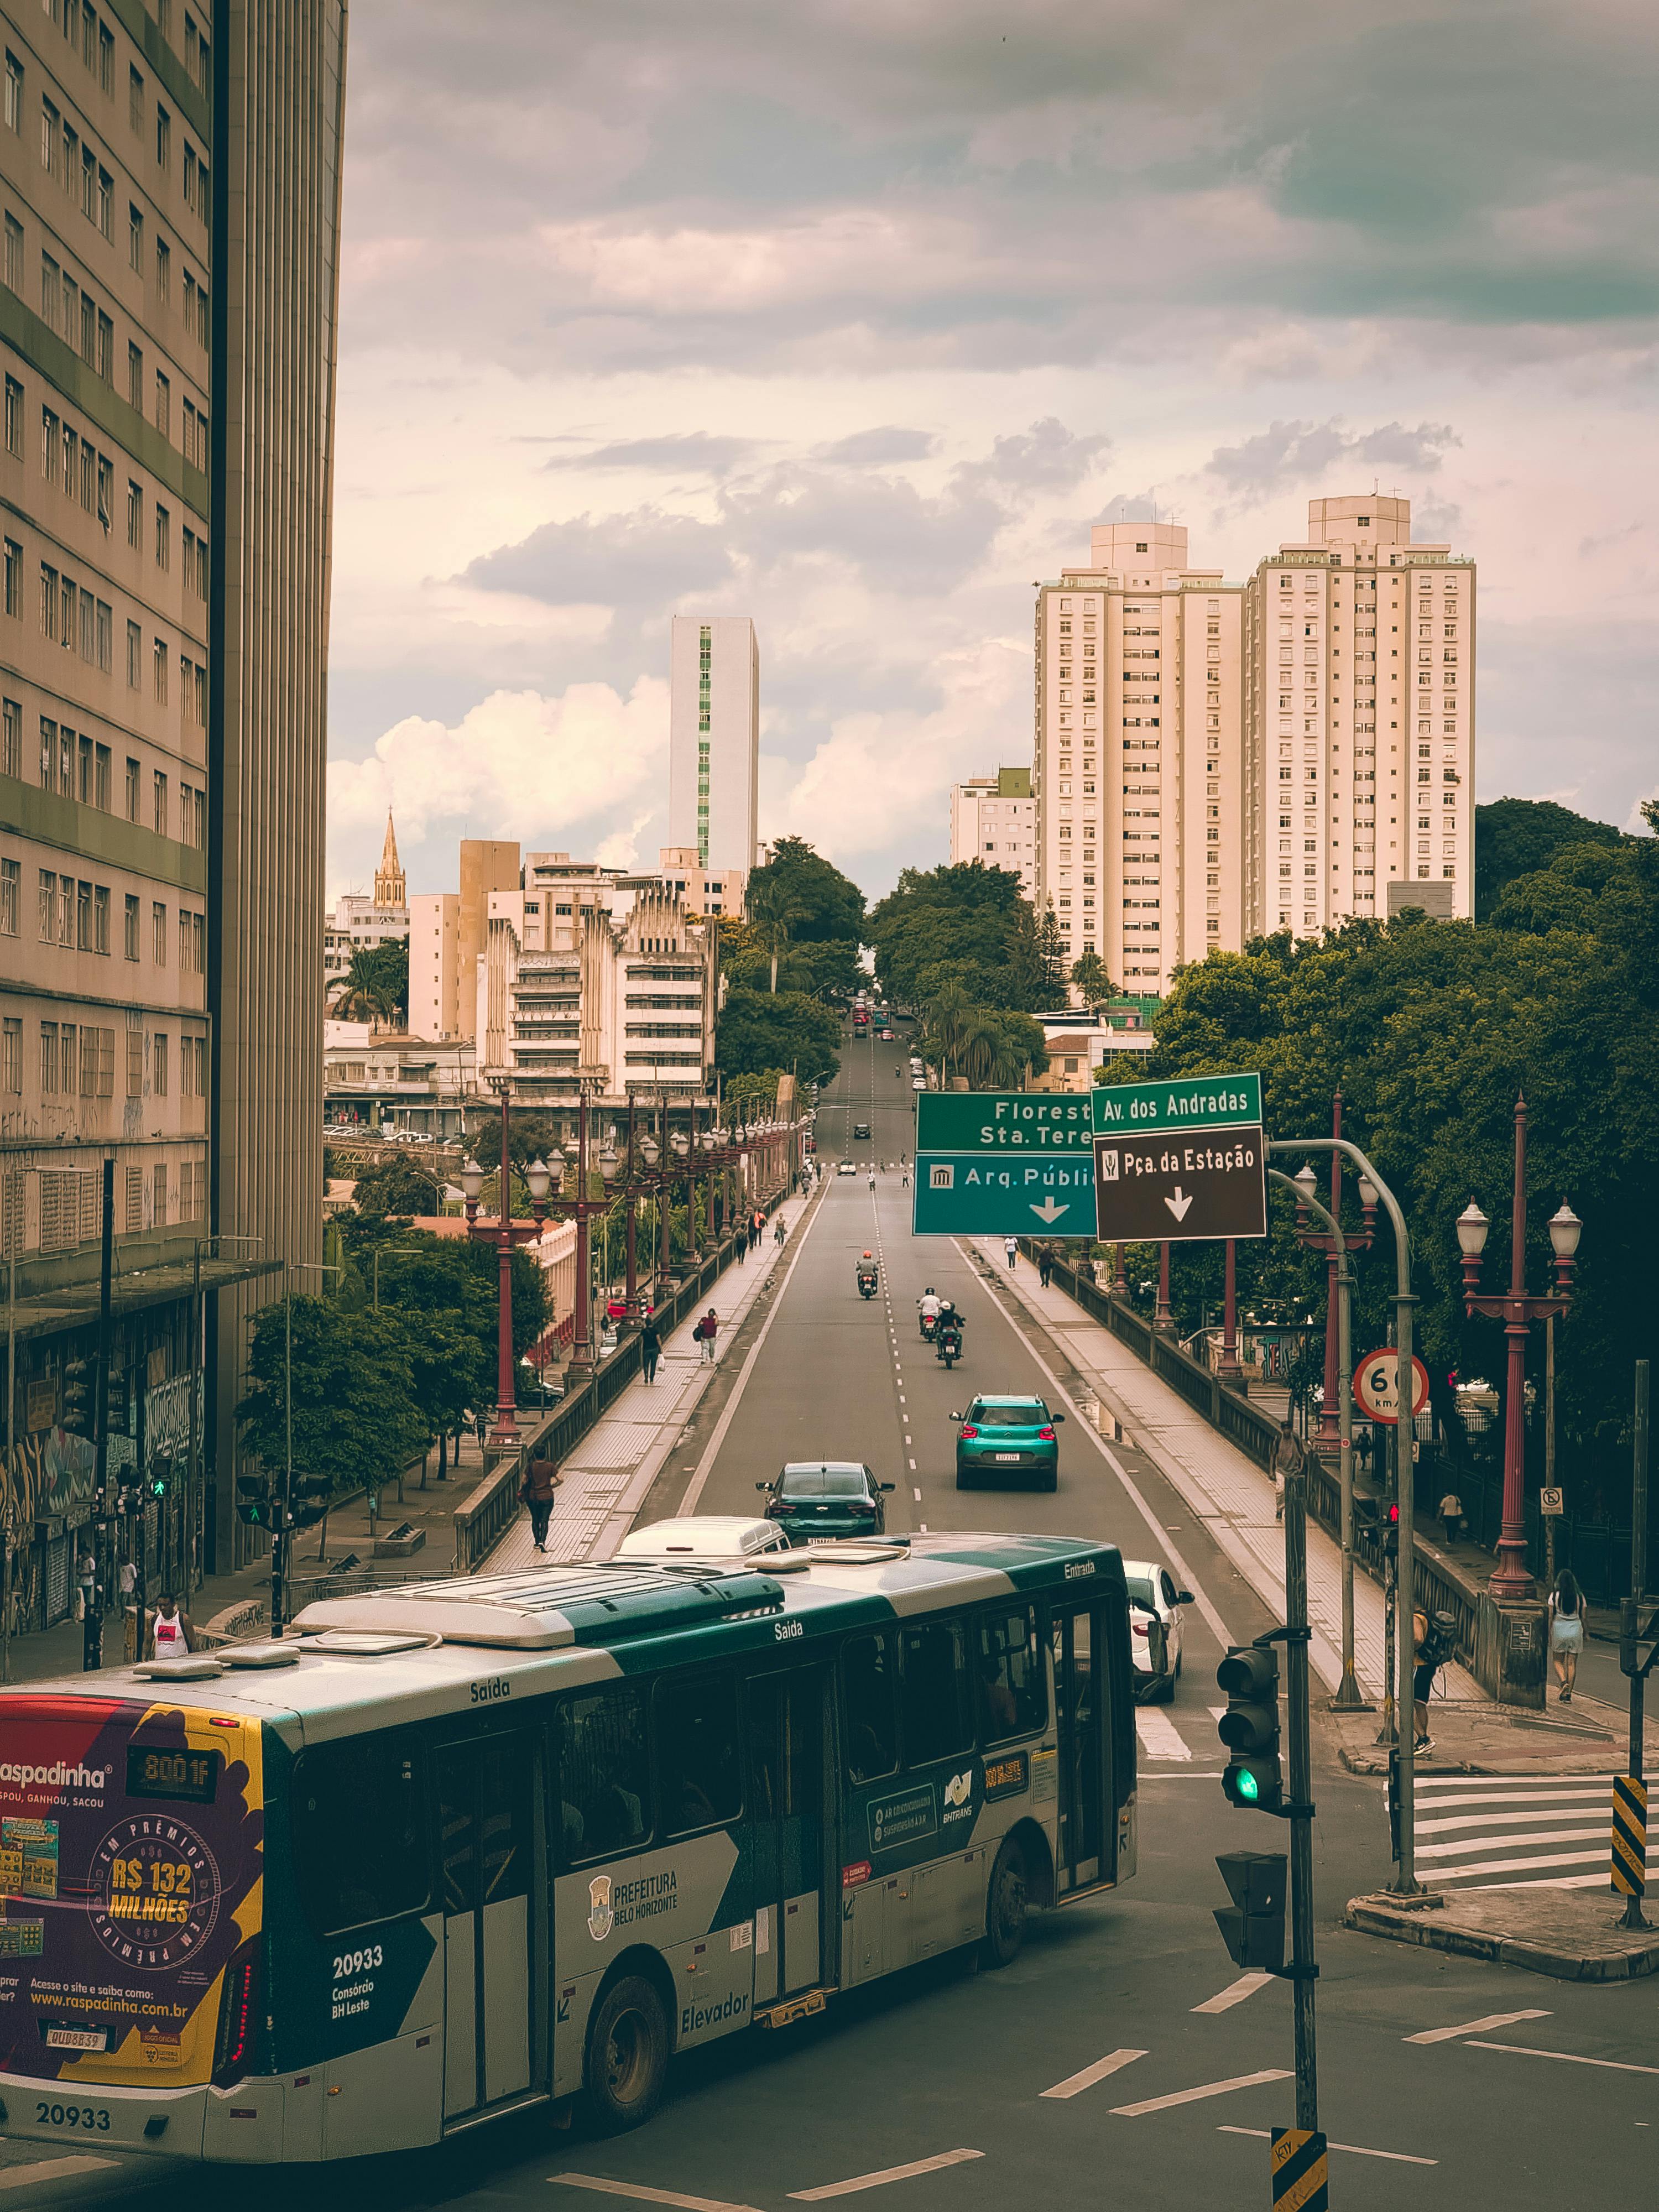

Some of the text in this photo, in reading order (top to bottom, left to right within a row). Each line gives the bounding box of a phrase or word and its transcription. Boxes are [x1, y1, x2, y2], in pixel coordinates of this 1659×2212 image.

[1104, 1091, 1248, 1122] Av. dos Andradas
[980, 1126, 1029, 1144] Sta.
[1124, 1144, 1254, 1177] Pça. da Estação
[965, 1168, 1017, 1188] Arq.
[1370, 1368, 1398, 1392] 6
[1064, 1559, 1095, 1579] Entrada
[774, 1620, 804, 1641] Saída
[469, 1677, 511, 1703] Saída
[28, 1793, 70, 1807] GANHOU,
[73, 1797, 104, 1808] SACOU
[943, 1805, 972, 1824] BHTRANS
[100, 1837, 119, 1862] EM
[112, 1858, 191, 1894] R$ 132
[614, 1870, 677, 1907] PREFEITURA
[108, 1893, 190, 1923] MILHÕES
[614, 1893, 677, 1927] BELO HORIZONTE
[332, 1945, 383, 1979] 20933
[0, 1990, 15, 2002] er?
[30, 1978, 61, 1990] Acesse
[71, 1982, 87, 1994] site
[97, 1985, 123, 1997] saiba
[125, 1989, 154, 2000] como:
[332, 1978, 374, 2001] Consórcio
[30, 1992, 189, 2018] www.raspadinha.com.br
[332, 1999, 369, 2020] BH Leste
[681, 1990, 749, 2034] Elevador
[35, 2103, 111, 2131] 20933
